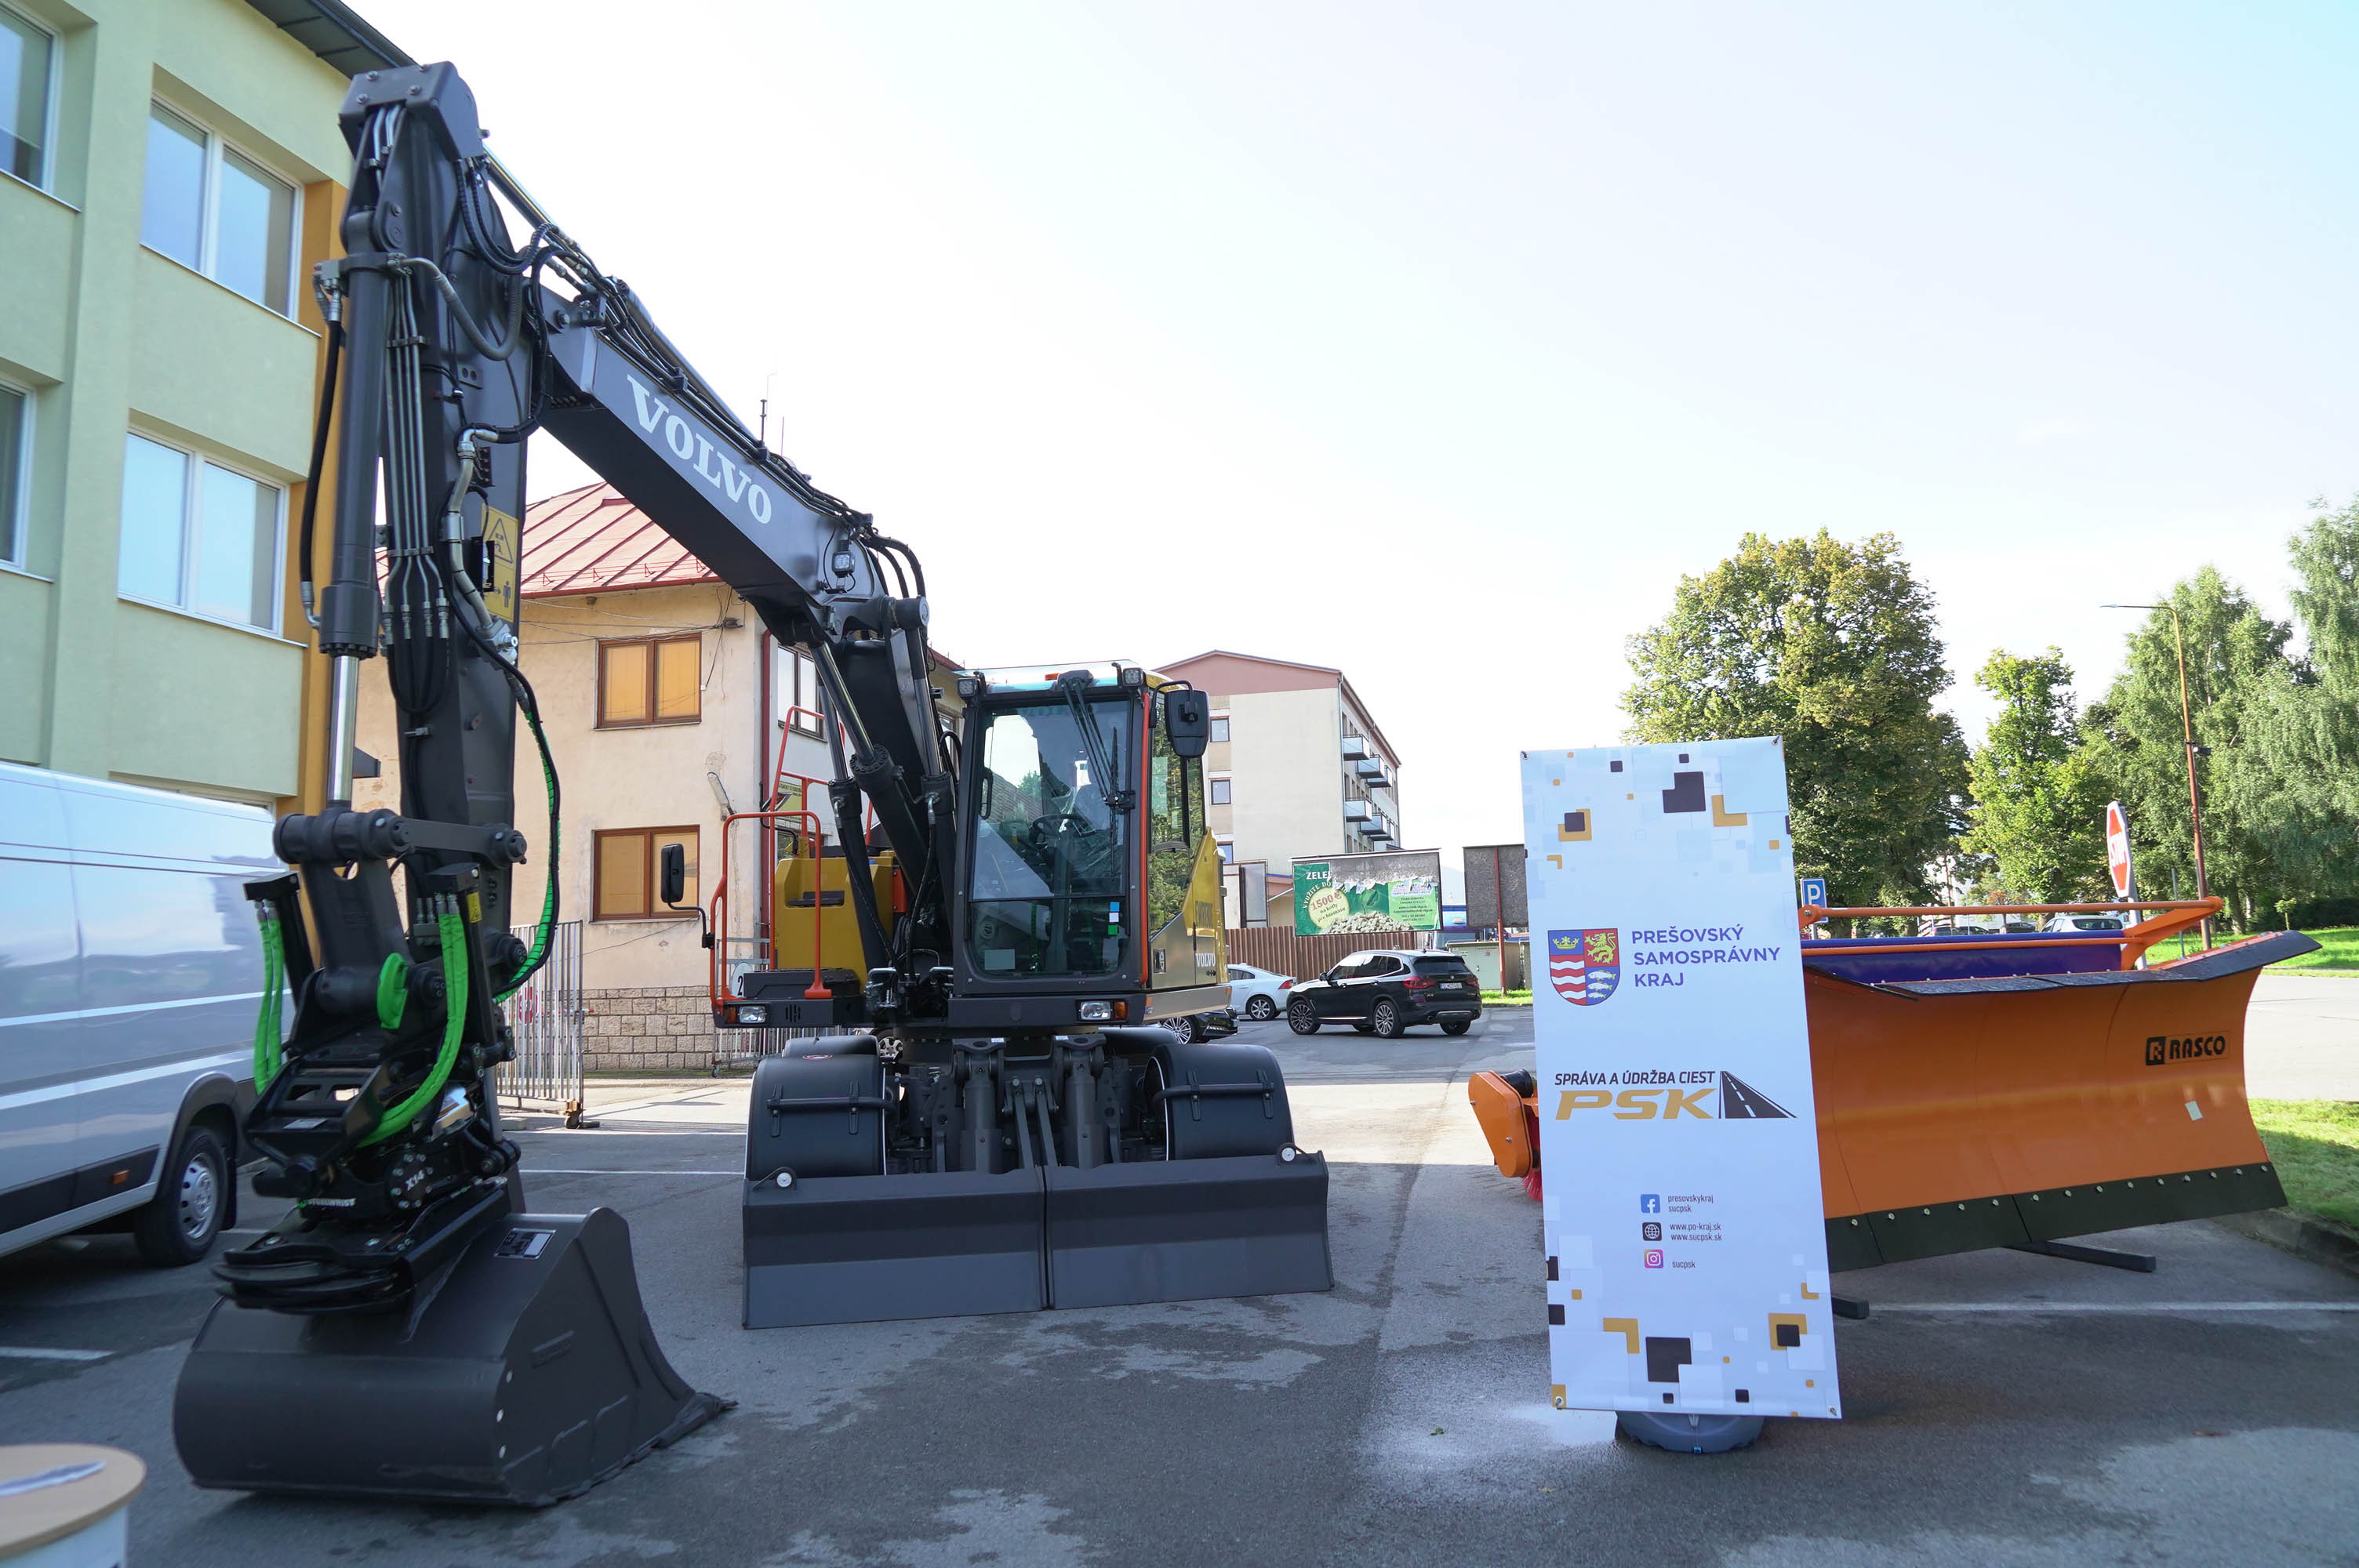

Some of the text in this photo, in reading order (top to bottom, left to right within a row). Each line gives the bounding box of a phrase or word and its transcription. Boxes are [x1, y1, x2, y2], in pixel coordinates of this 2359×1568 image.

[627, 374, 772, 524] VOLVO
[1807, 884, 1820, 905] P
[1311, 895, 1333, 910] 1500
[1632, 924, 1744, 944] PREŠOVSKÝ
[1195, 953, 1216, 967] VOLVO
[1634, 946, 1780, 965] SAMOSPRÁVNY
[1634, 972, 1684, 987] KRAJ
[2169, 1036, 2226, 1059] RASCO
[1554, 1069, 1716, 1086] SPRÁVA A ÚDRŽBA CIEST
[1556, 1088, 1717, 1120] PSK
[1667, 1194, 1714, 1203] presovskykraj
[1668, 1204, 1692, 1214] sucpsk
[1670, 1223, 1721, 1232] www.po-kraj.sk
[1670, 1233, 1722, 1242] www.sucpsk.sk
[1672, 1261, 1696, 1269] sucpsk
